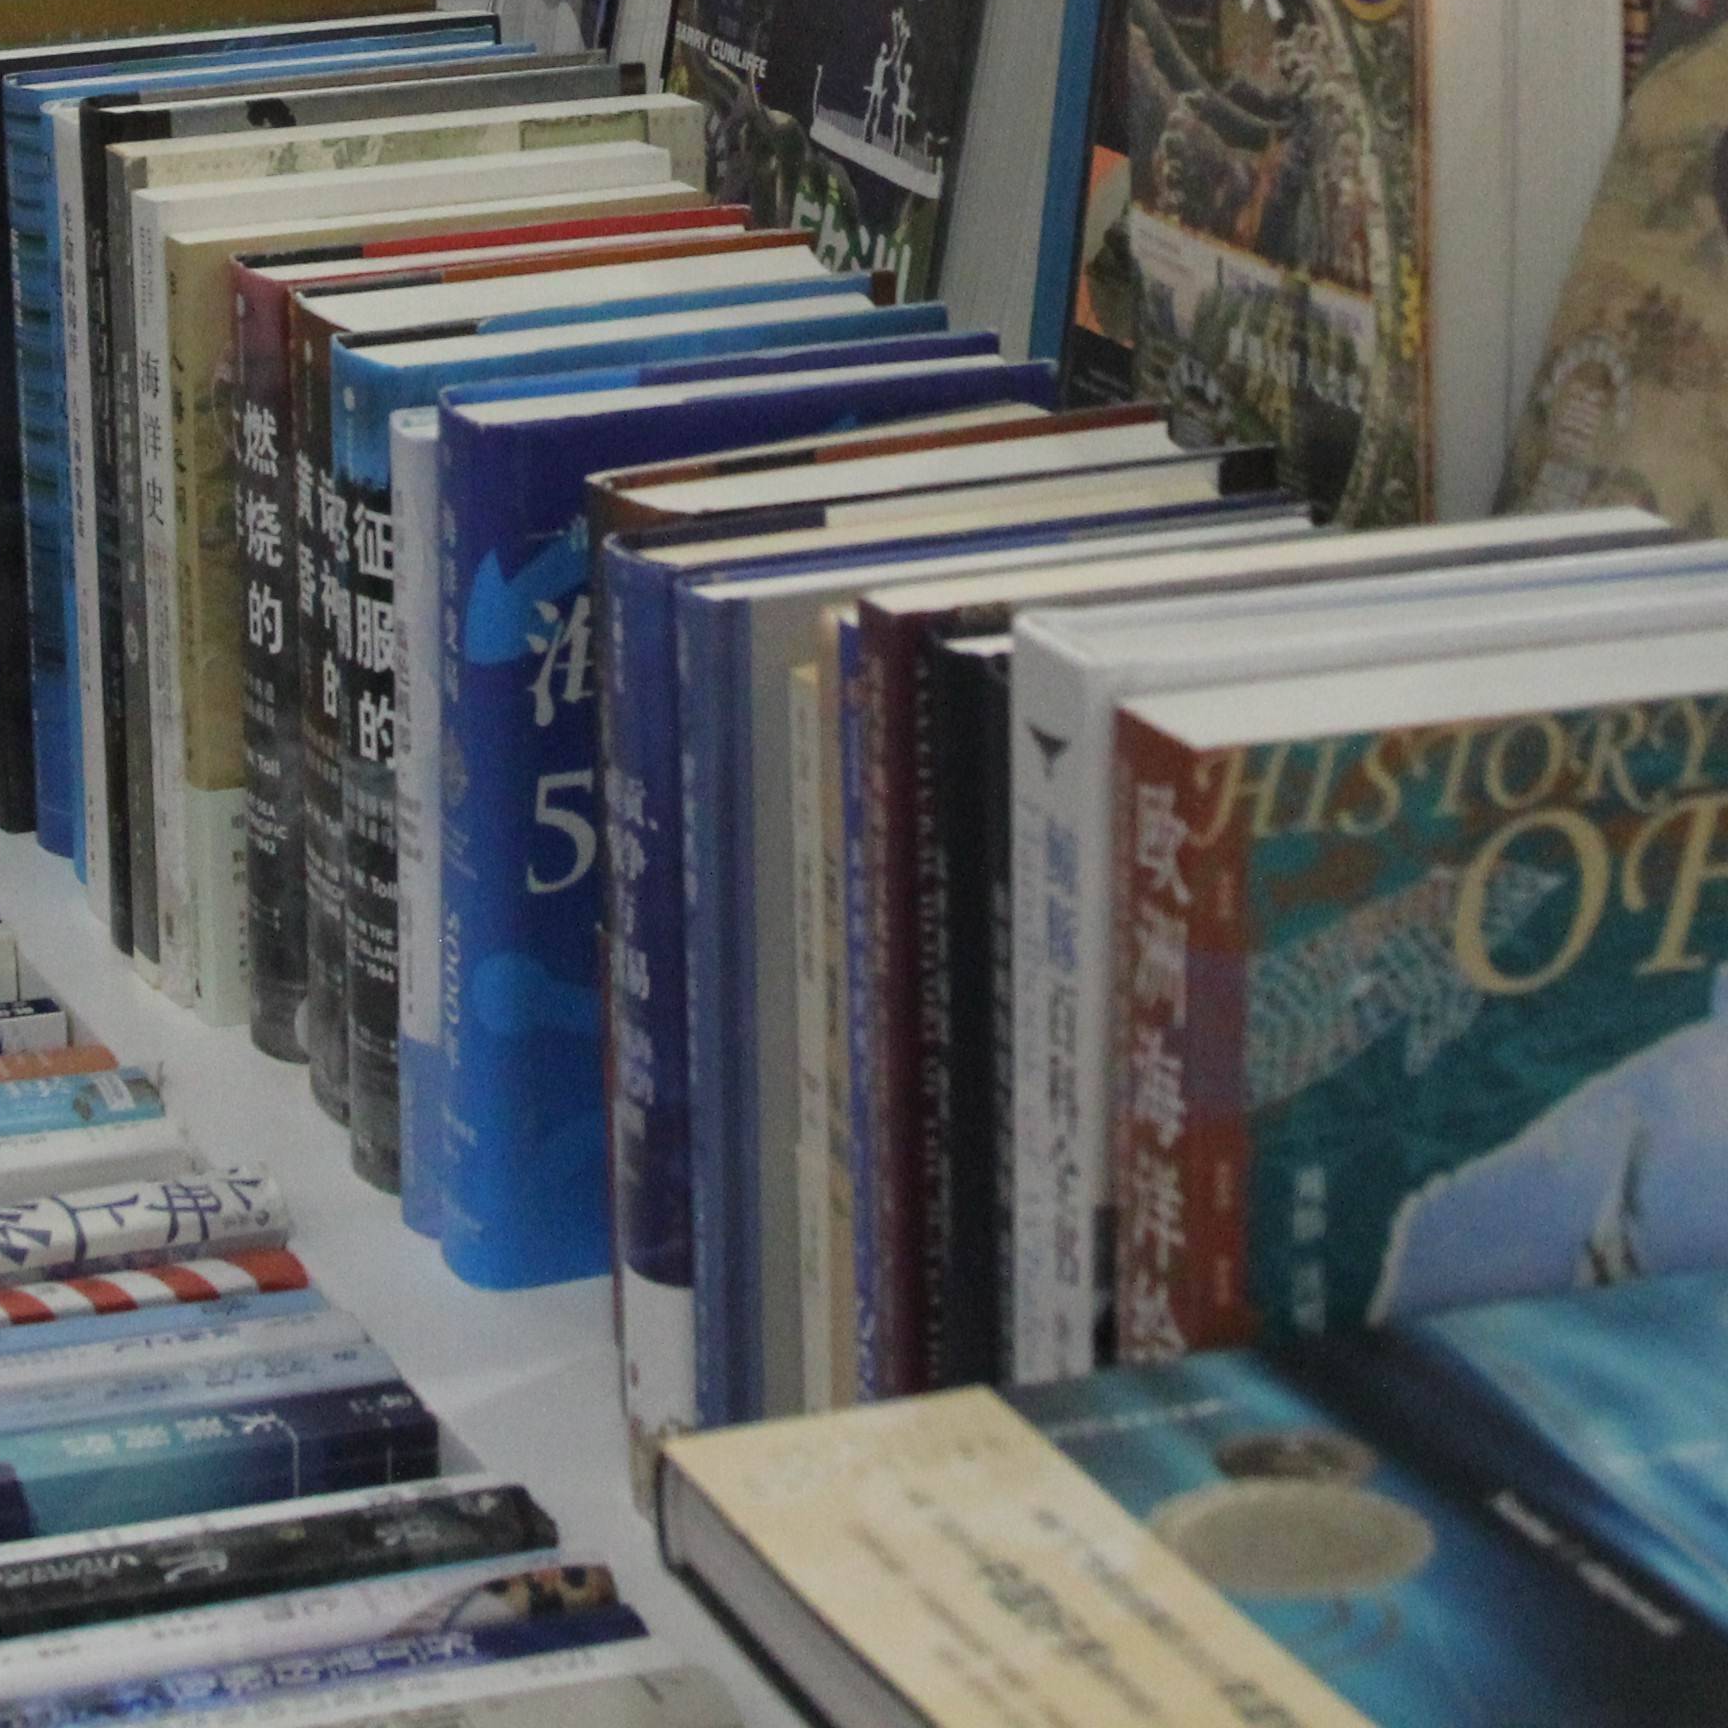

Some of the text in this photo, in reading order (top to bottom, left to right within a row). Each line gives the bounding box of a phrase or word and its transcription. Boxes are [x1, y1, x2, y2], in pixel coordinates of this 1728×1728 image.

[711, 37, 769, 79] CUNLIFFE
[241, 399, 284, 655] 燃烧的
[352, 500, 397, 771] 征服的
